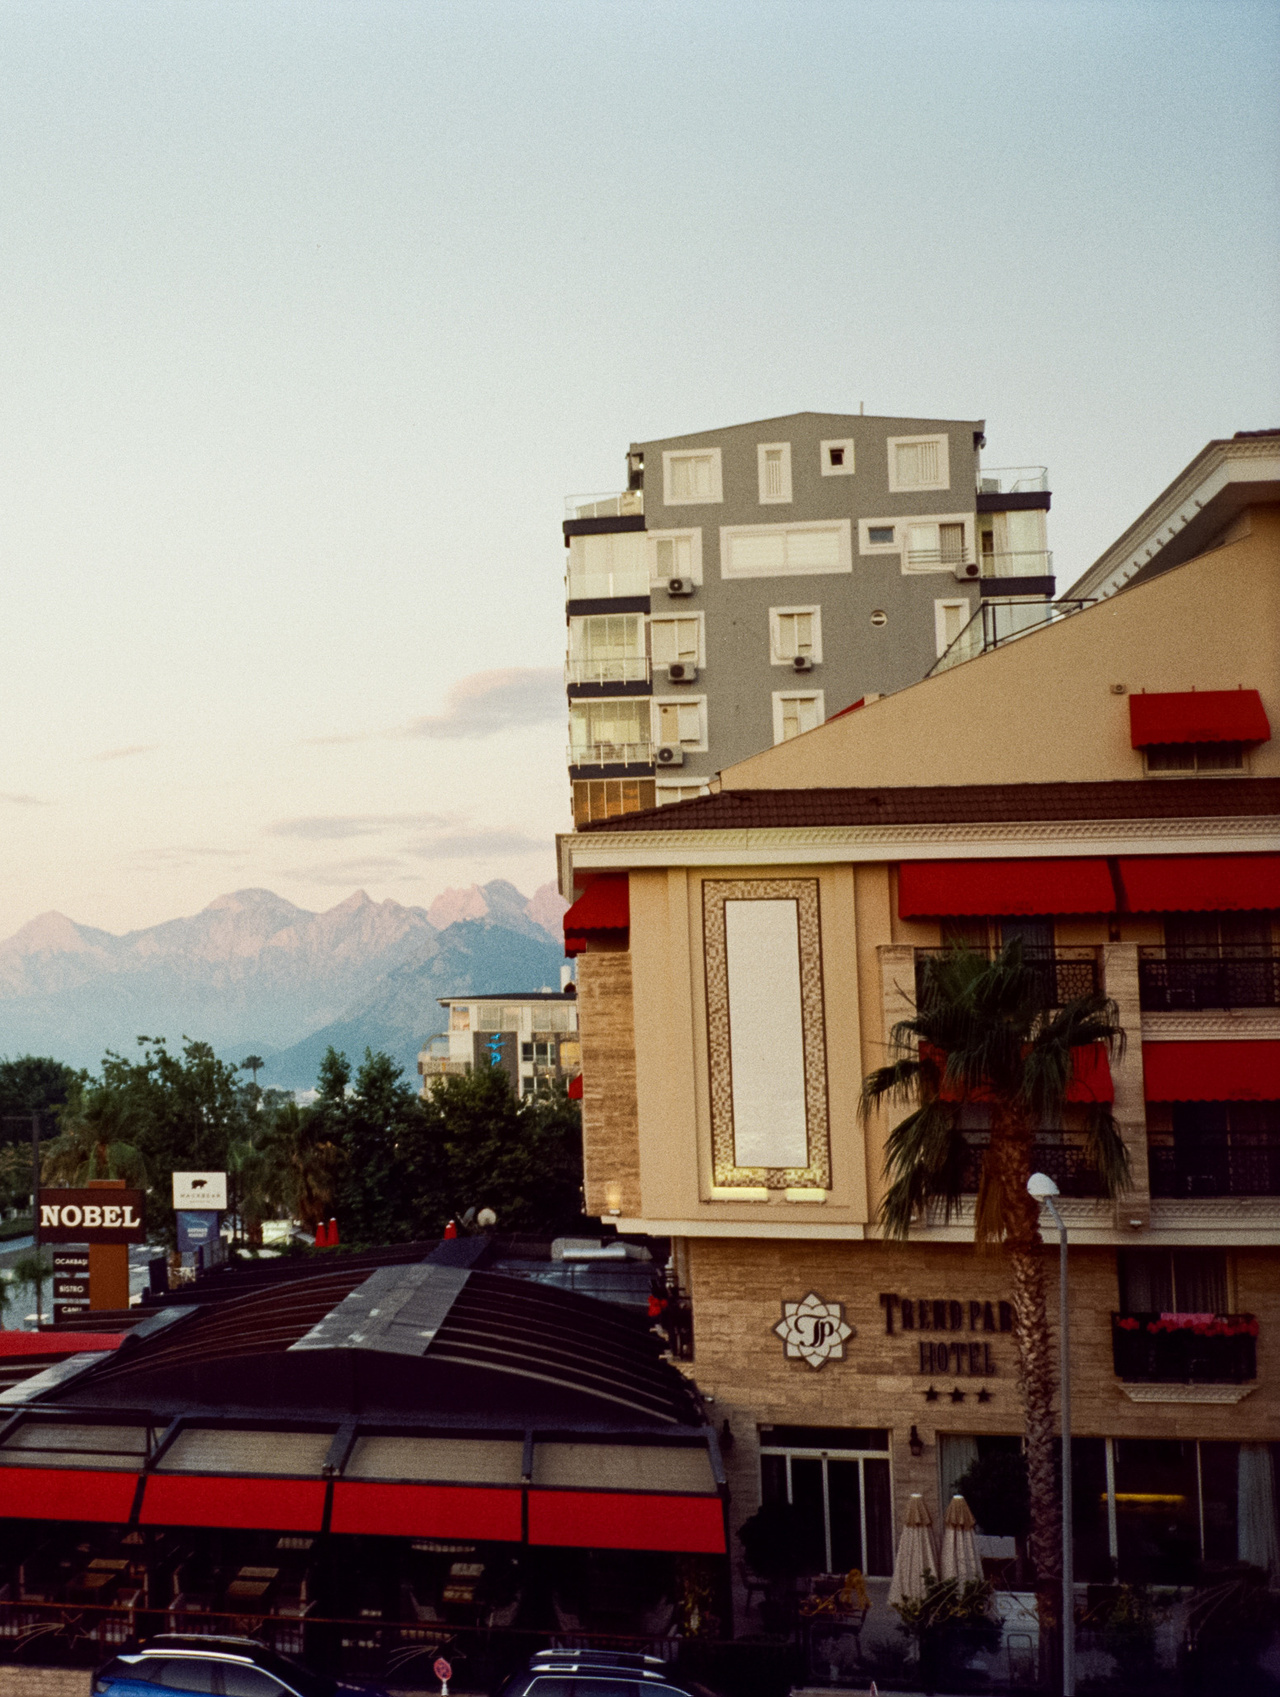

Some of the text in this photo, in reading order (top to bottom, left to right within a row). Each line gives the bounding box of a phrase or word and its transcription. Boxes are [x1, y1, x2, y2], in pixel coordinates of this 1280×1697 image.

[40, 1205, 140, 1227] NOBEL
[880, 1293, 1014, 1335] TREND PAR
[919, 1342, 996, 1374] HOTEL
